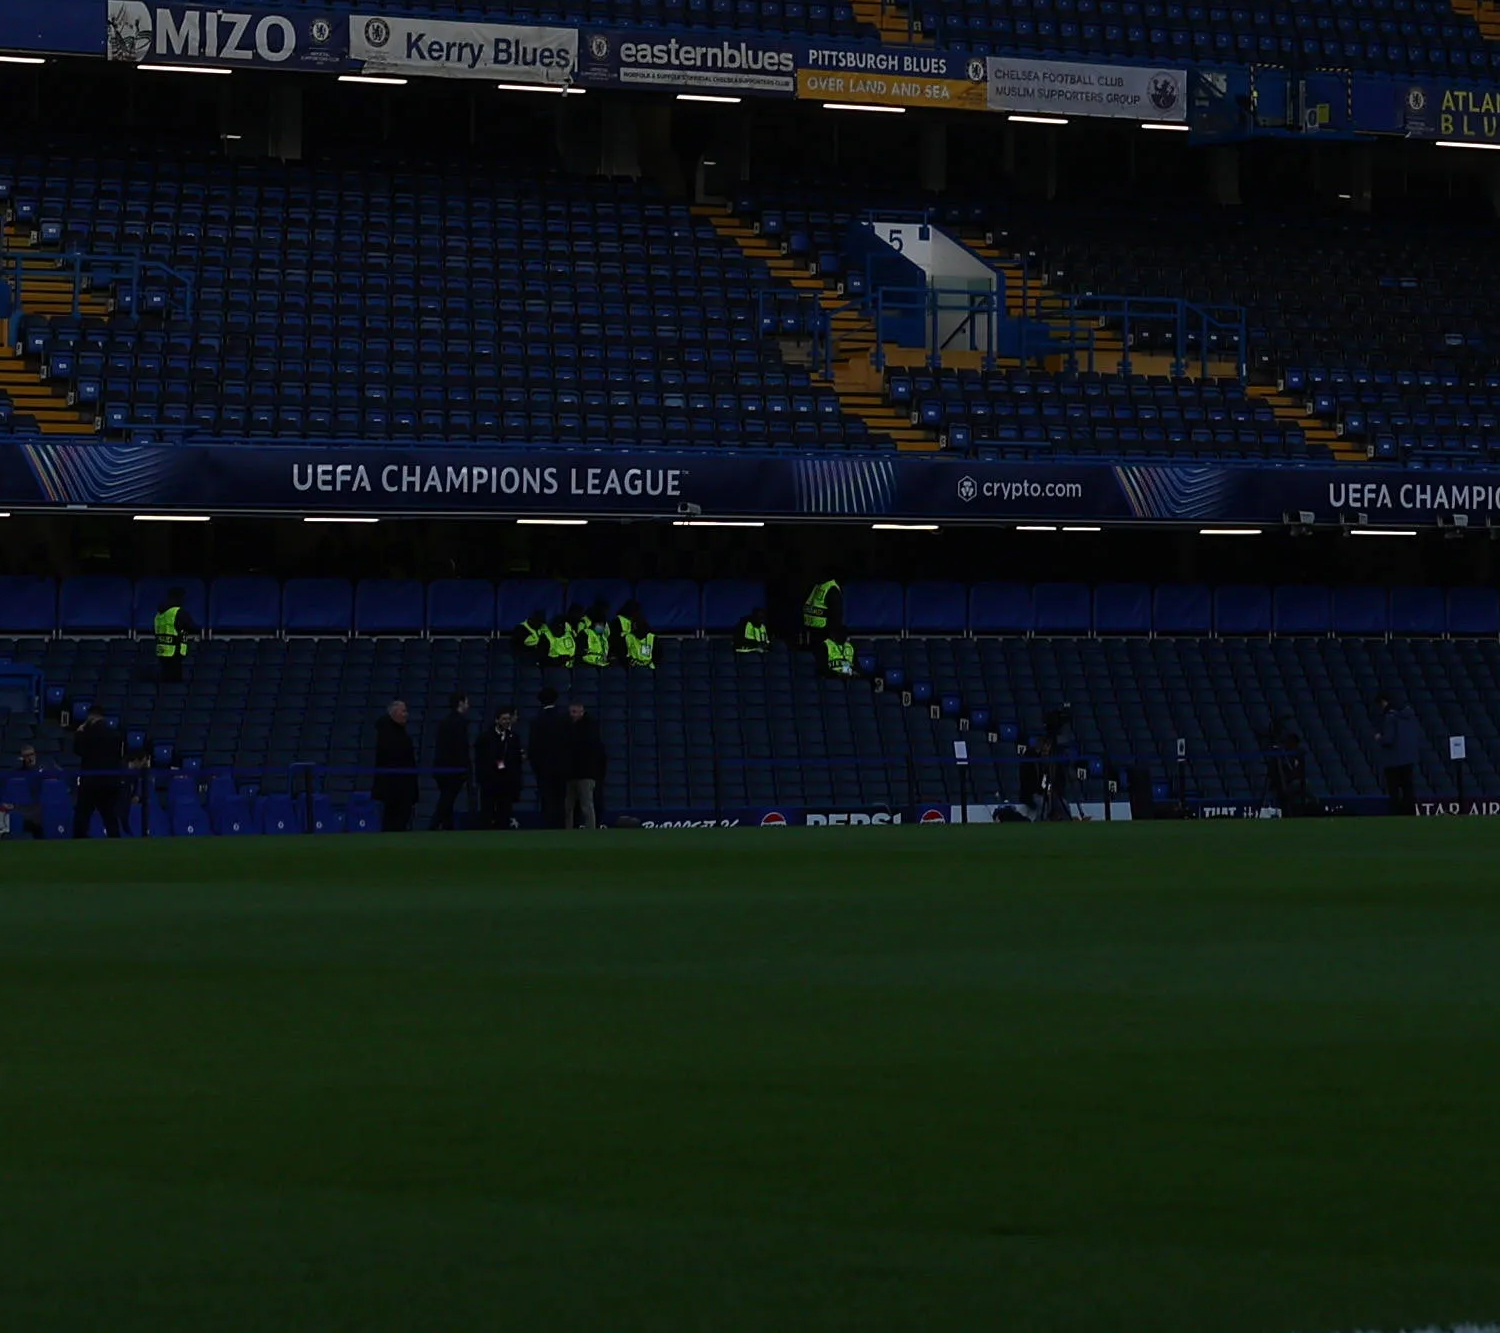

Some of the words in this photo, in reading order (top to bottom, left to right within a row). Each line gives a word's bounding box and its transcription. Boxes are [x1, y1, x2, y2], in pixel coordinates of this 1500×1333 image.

[406, 31, 484, 69] Kerry
[493, 37, 570, 68] Blues
[619, 37, 794, 71] easternblues
[808, 49, 899, 71] PITTSBURGH
[903, 56, 947, 75] BLUES
[807, 77, 844, 93] OVER
[850, 79, 887, 95] LAND
[891, 83, 921, 97] AND
[924, 85, 950, 100] SEA
[994, 69, 1039, 82] CHELSEA
[1042, 72, 1095, 86] FOOTBALL
[1097, 75, 1124, 87] CLUB
[995, 86, 1035, 99] MUSLIM
[1037, 88, 1104, 103] SUPPORTERS
[1106, 93, 1141, 106] GROUP
[889, 229, 903, 252] 5
[293, 463, 372, 493] UEFA
[381, 464, 559, 495] CHAMPIONS
[982, 479, 1082, 500] crypto.com
[1329, 483, 1393, 509] UEFA
